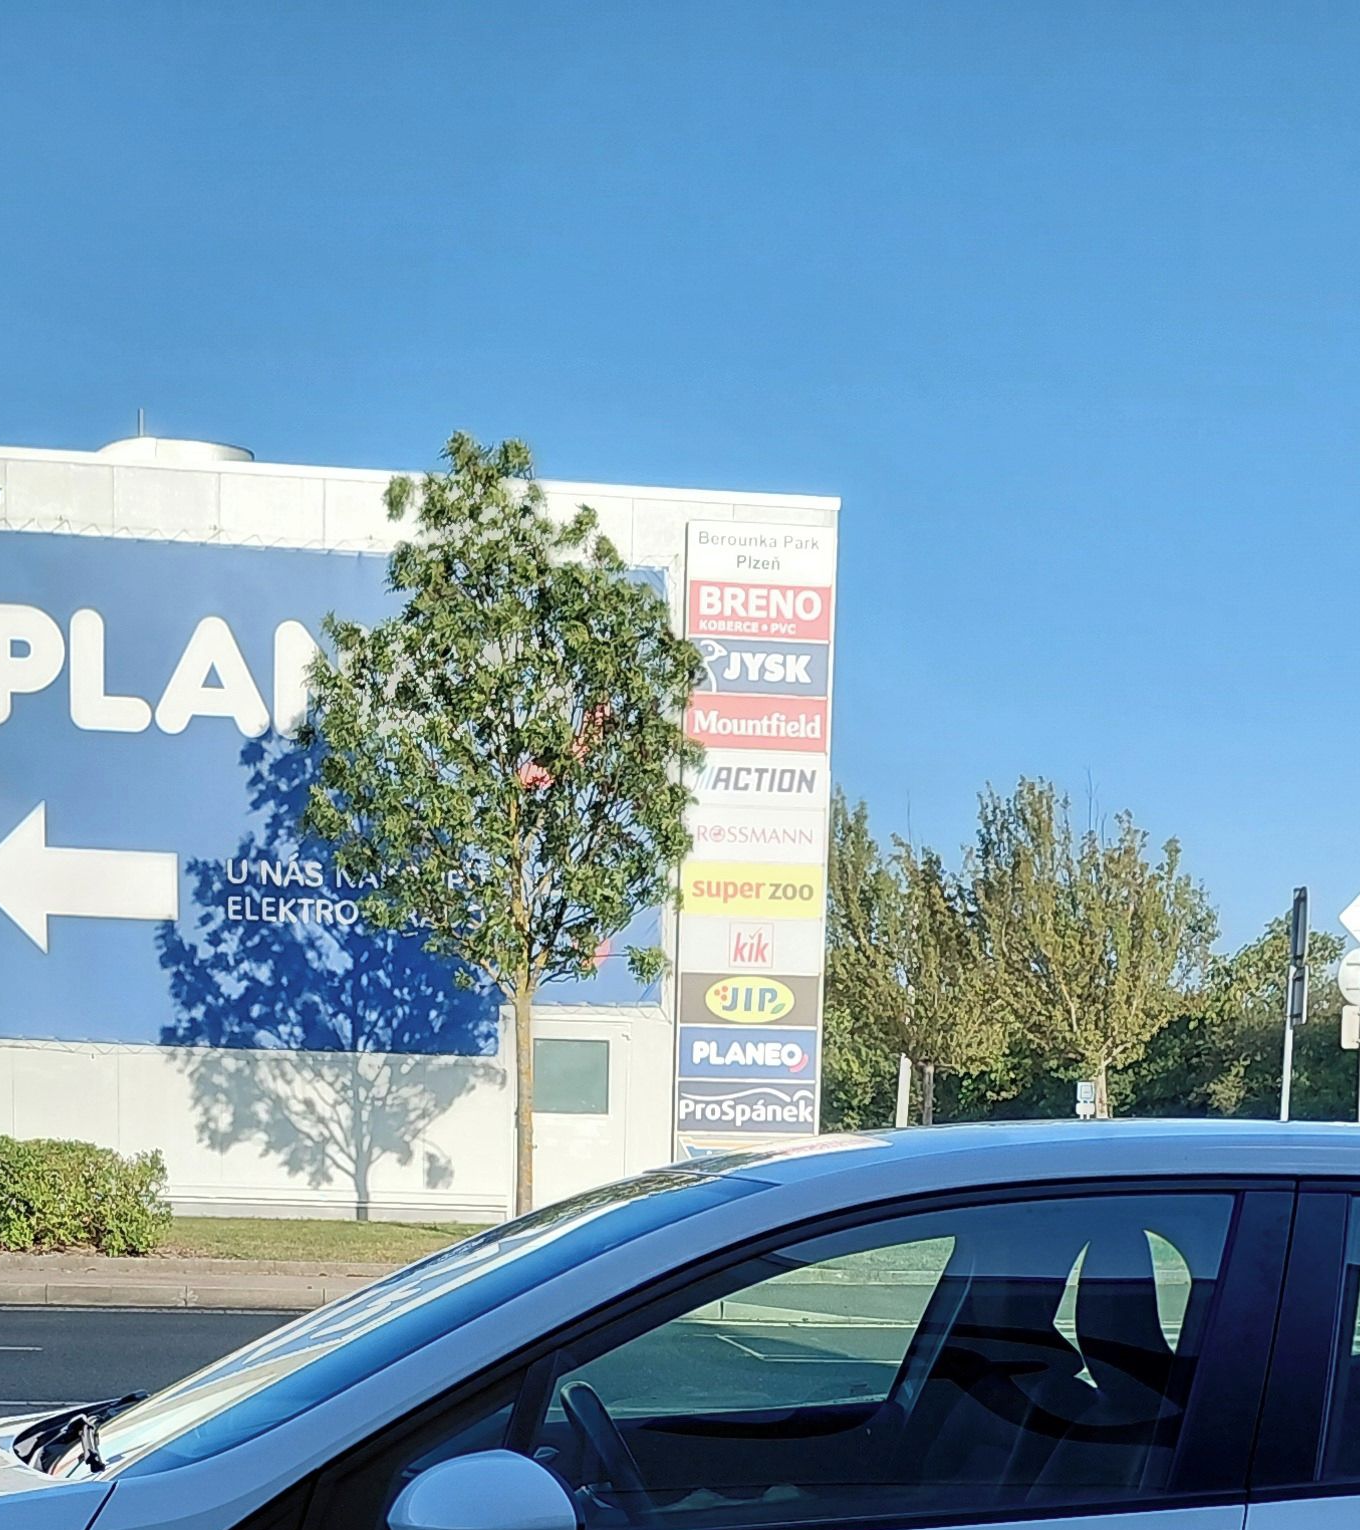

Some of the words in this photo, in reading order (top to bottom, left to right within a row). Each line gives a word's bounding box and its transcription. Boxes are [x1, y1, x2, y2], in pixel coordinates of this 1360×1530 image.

[698, 531, 777, 548] Berounka
[783, 535, 820, 550] Park
[736, 554, 781, 570] Plzeň
[698, 585, 822, 621] BRENO
[698, 619, 759, 633] KOBERCE
[770, 623, 797, 635] PVC
[723, 651, 812, 684] JYSK
[692, 709, 822, 739] Mountfield
[711, 766, 817, 794] ACTION
[696, 825, 813, 844] ROSSMANN
[226, 858, 249, 885] U
[259, 852, 324, 888] NÁS
[226, 895, 360, 926] ELEKTRO
[721, 987, 779, 1012] JIP
[691, 1040, 803, 1067] PLANEO
[679, 1098, 814, 1127] ProSpánek
